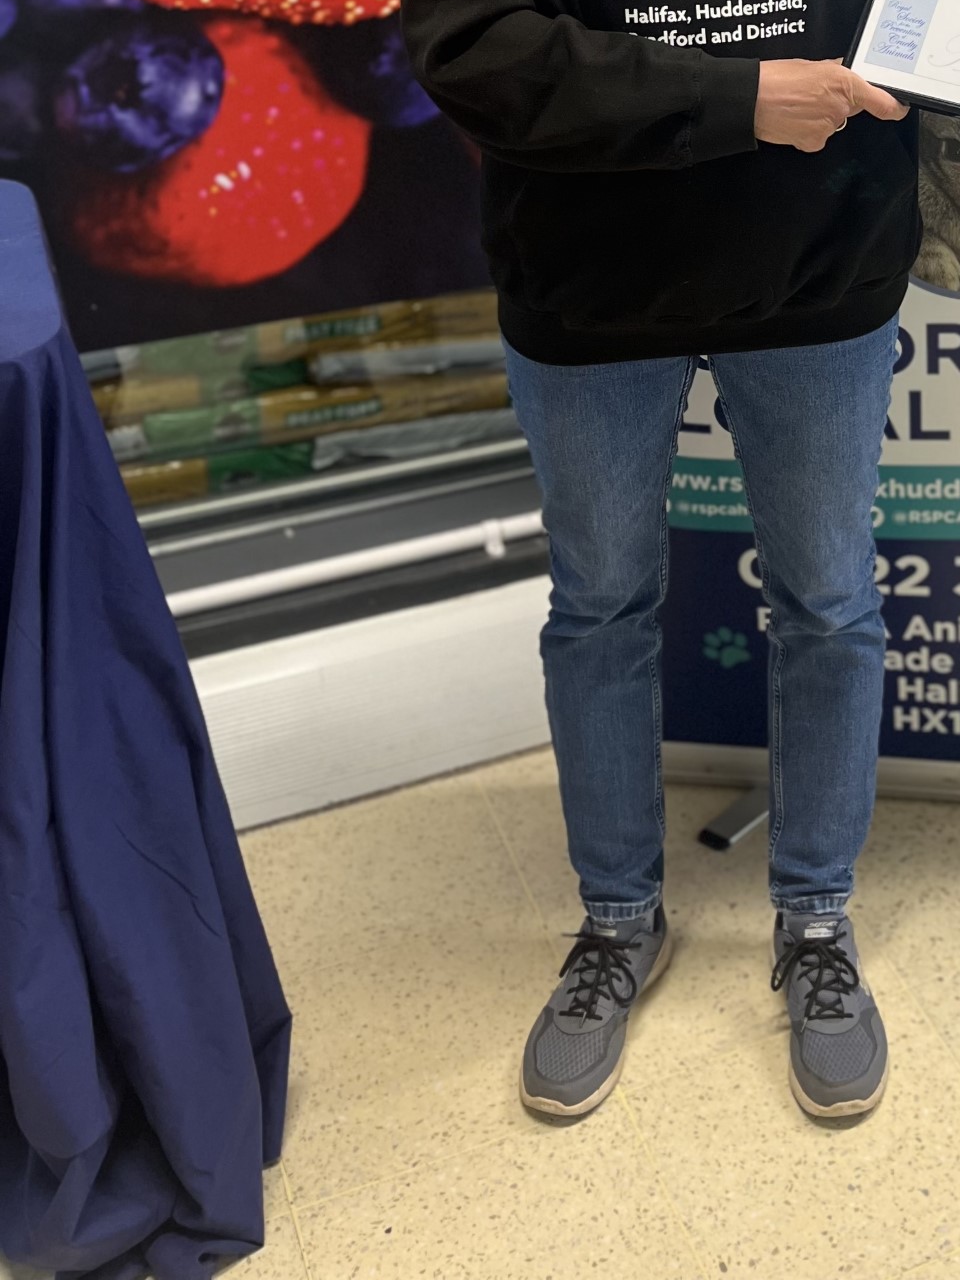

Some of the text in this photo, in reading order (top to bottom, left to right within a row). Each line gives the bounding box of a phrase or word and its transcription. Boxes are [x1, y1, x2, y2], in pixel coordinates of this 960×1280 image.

[624, 6, 691, 24] Halifax,
[628, 18, 806, 47] dford and District
[883, 646, 954, 674] ade
